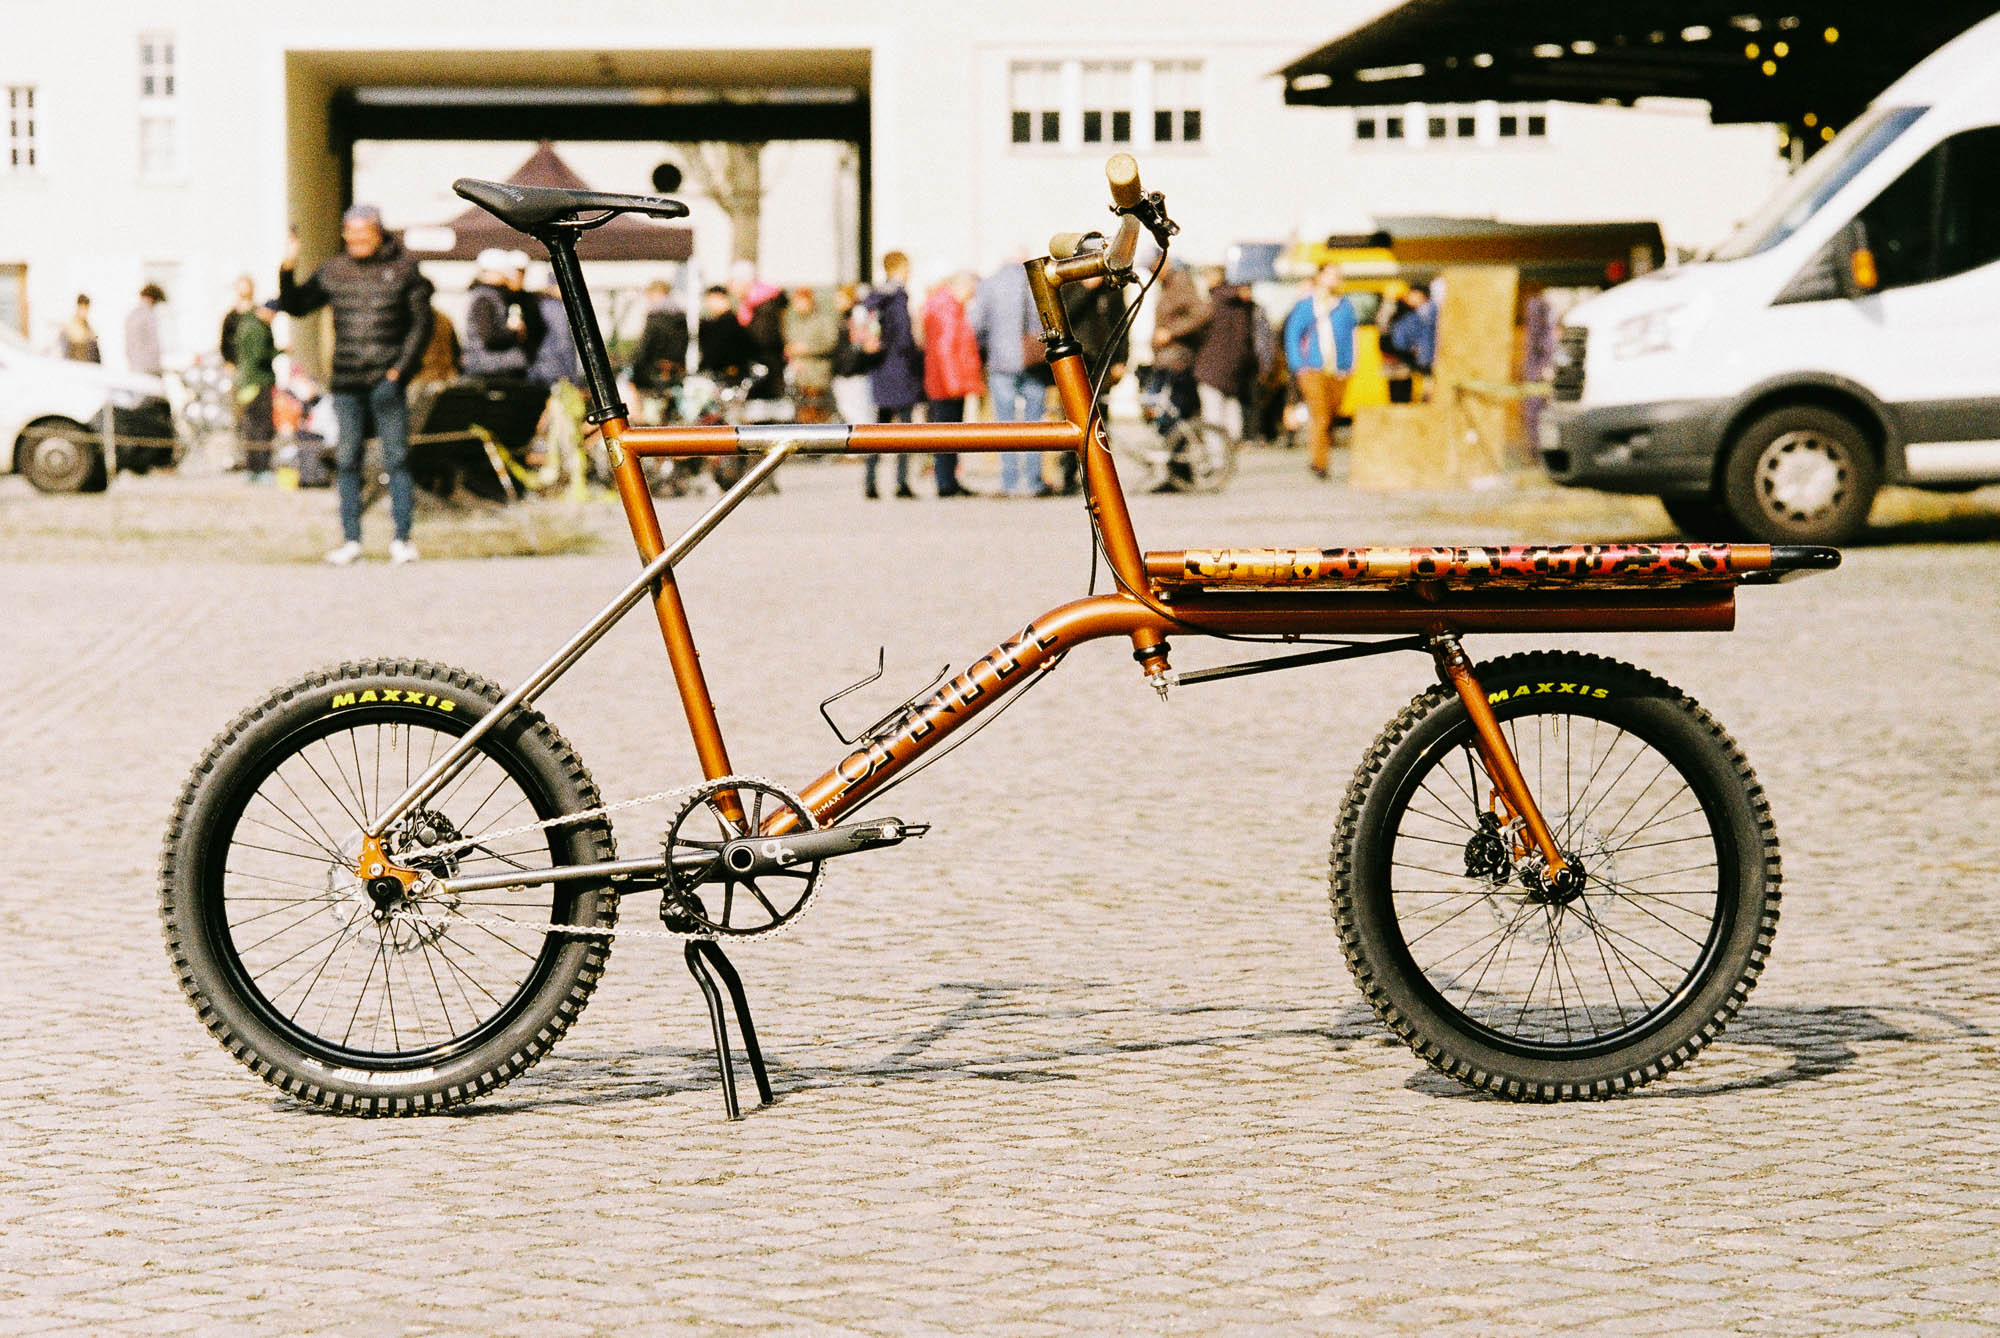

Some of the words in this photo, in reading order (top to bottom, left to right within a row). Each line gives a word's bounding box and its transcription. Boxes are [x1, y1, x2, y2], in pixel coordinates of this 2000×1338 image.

[332, 689, 456, 712] MAXXIS
[836, 623, 1058, 786] OMNIUM
[1488, 682, 1609, 705] MAXXIS
